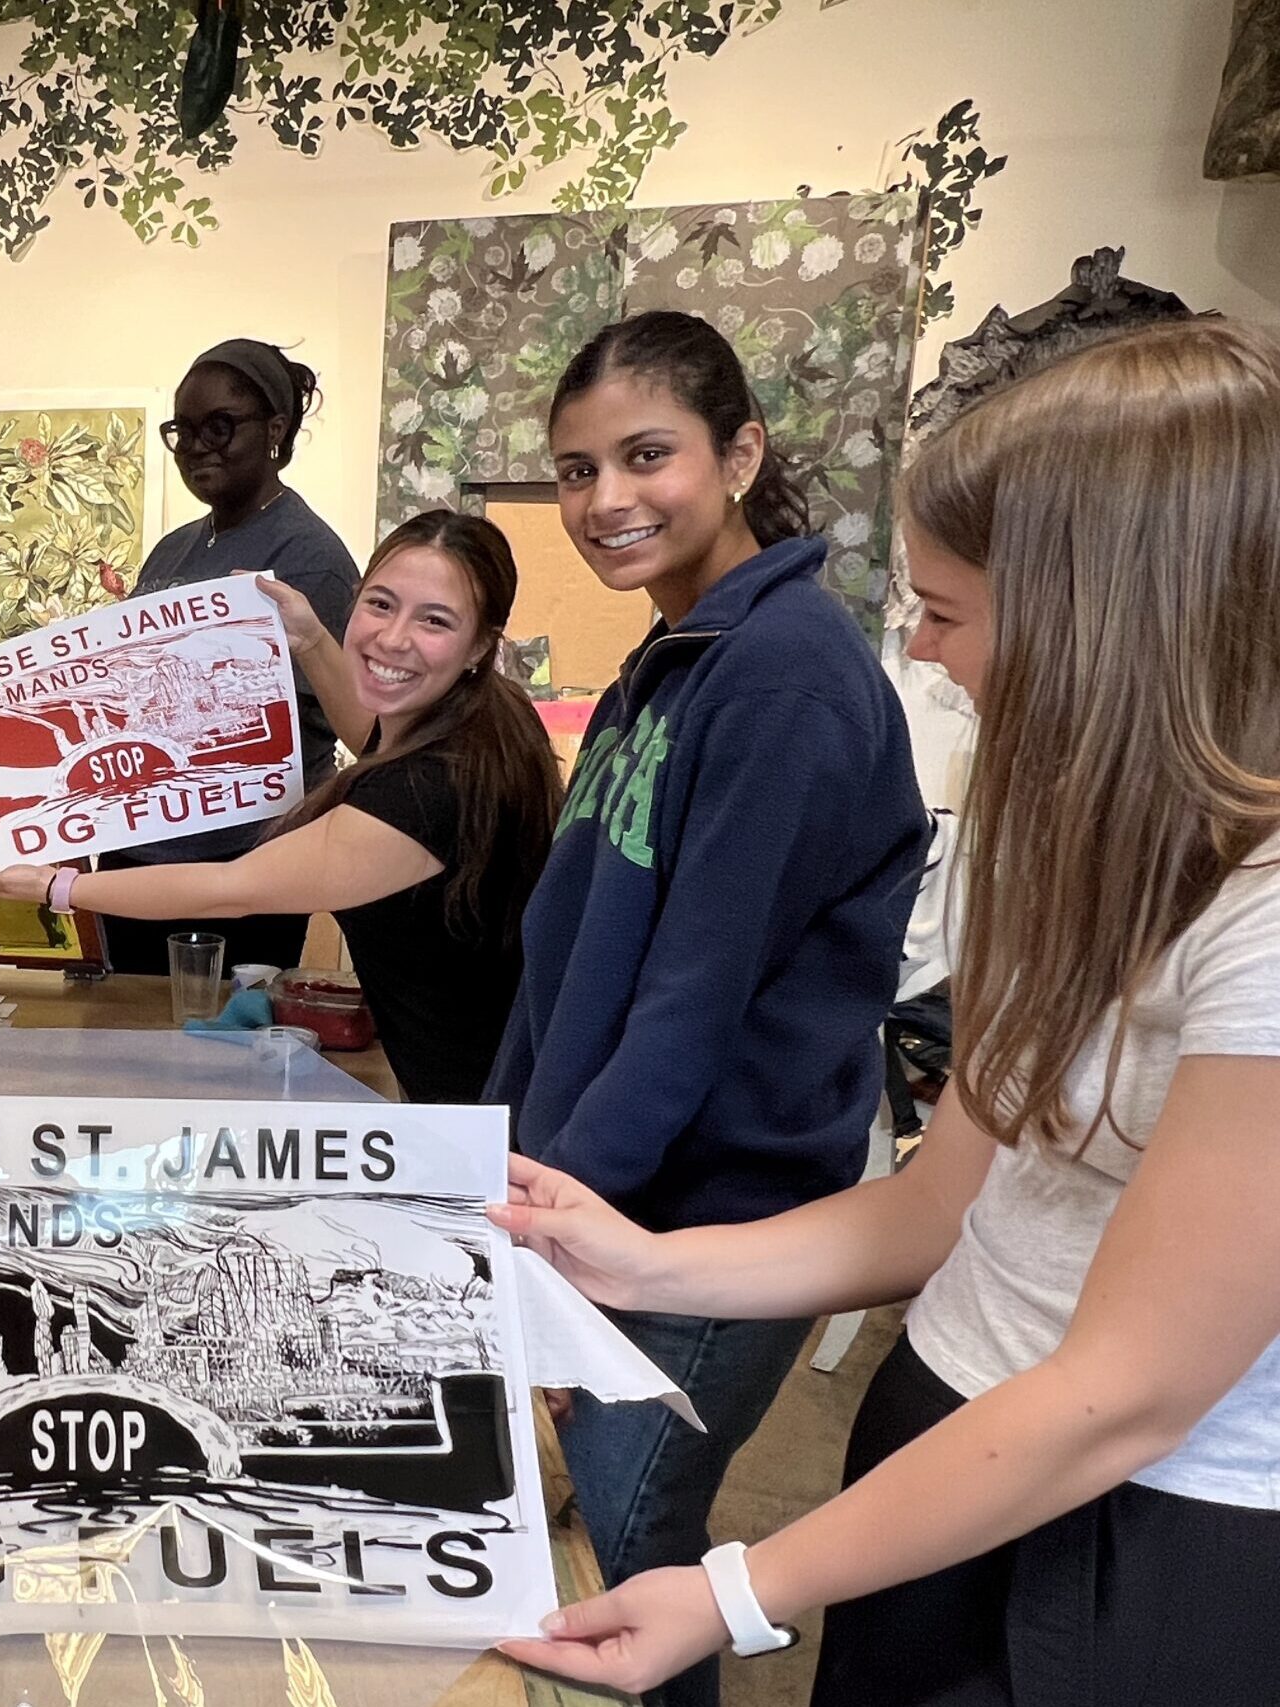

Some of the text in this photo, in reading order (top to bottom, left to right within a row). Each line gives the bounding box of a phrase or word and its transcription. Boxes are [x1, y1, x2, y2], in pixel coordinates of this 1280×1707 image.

[50, 626, 102, 657] ST.
[118, 592, 230, 639] JAMES
[87, 746, 145, 784] STOP
[11, 813, 96, 855] DG
[124, 772, 286, 831] FUELS
[31, 1123, 127, 1177] ST.
[163, 1126, 395, 1182] JAMES
[31, 1409, 147, 1472] STOP
